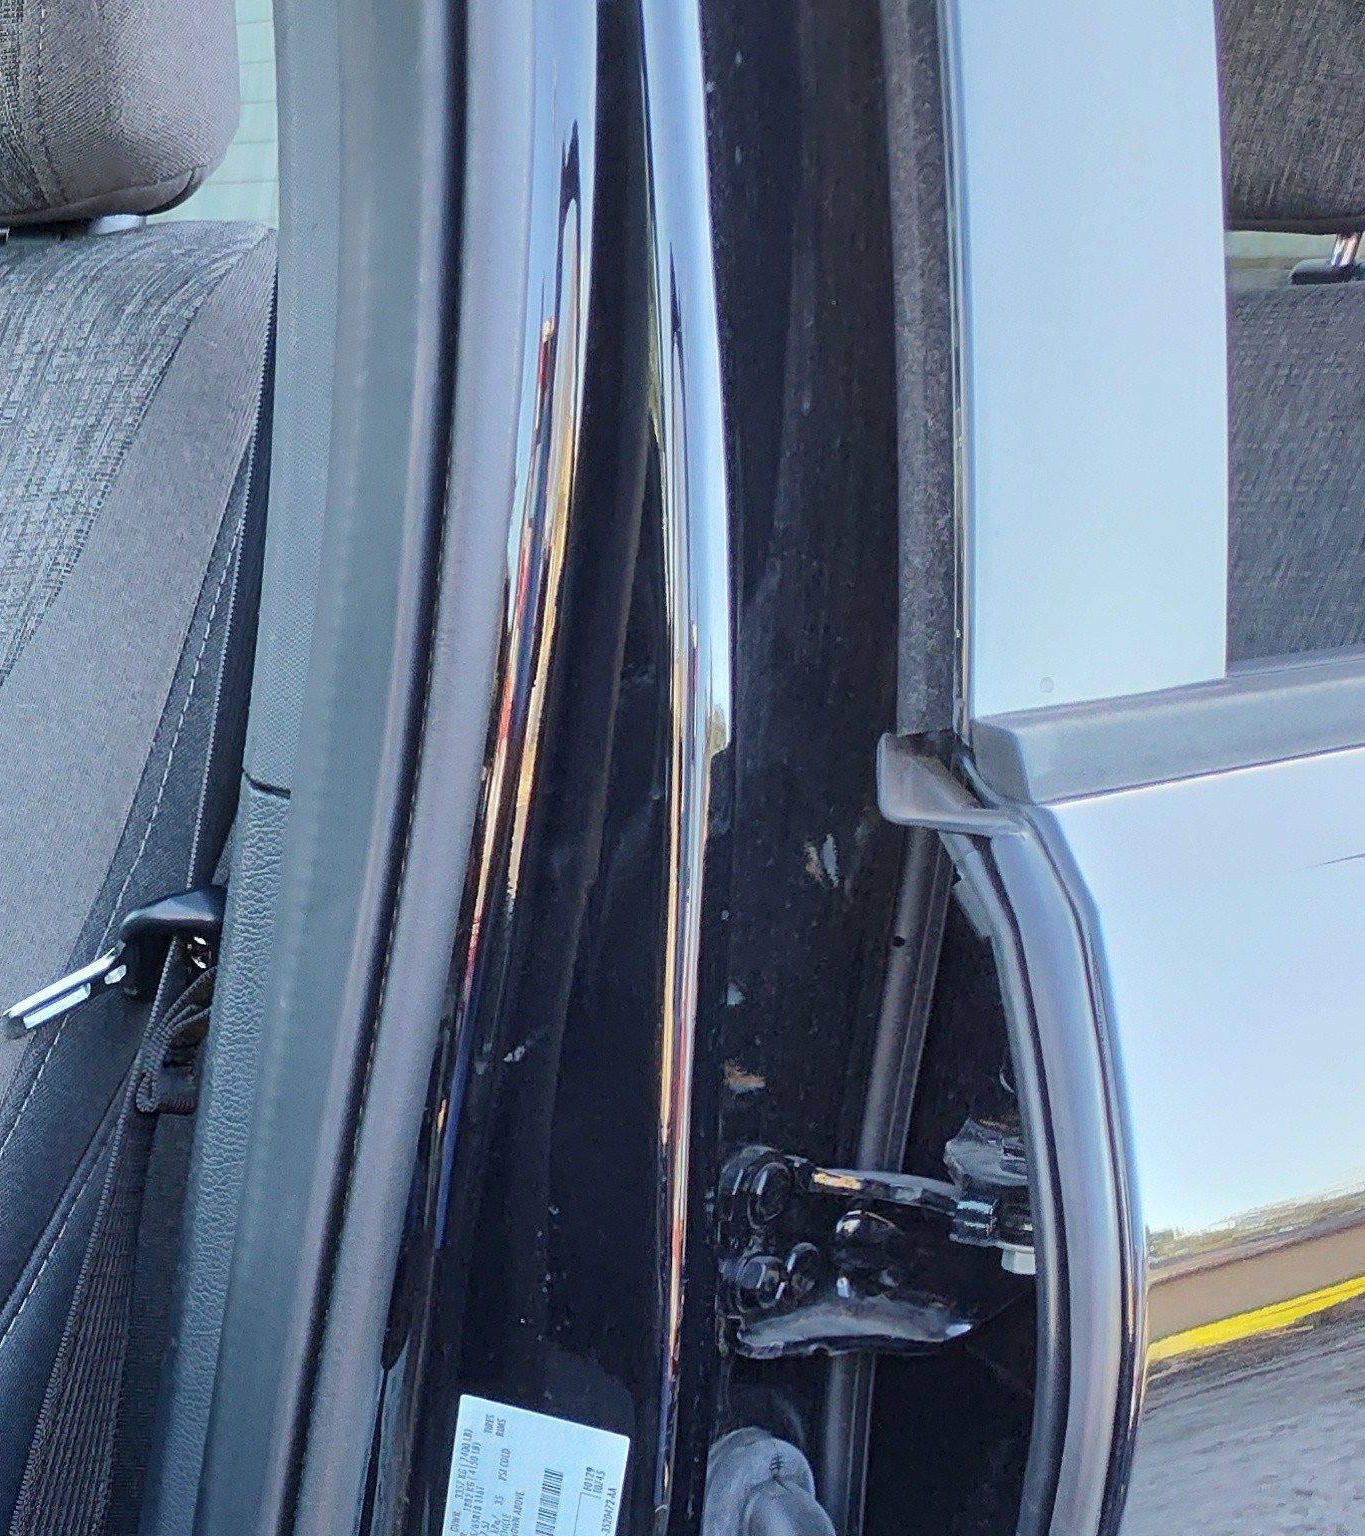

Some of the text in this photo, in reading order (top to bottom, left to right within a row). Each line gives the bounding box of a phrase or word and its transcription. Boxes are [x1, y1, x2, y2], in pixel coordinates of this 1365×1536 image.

[483, 1412, 495, 1434] TIRES
[459, 1441, 471, 1462] 7400
[499, 1446, 511, 1468] COLD
[457, 1467, 467, 1480] KG
[498, 1468, 508, 1481] PSI
[465, 1480, 475, 1493] KG
[494, 1494, 504, 1506] 35
